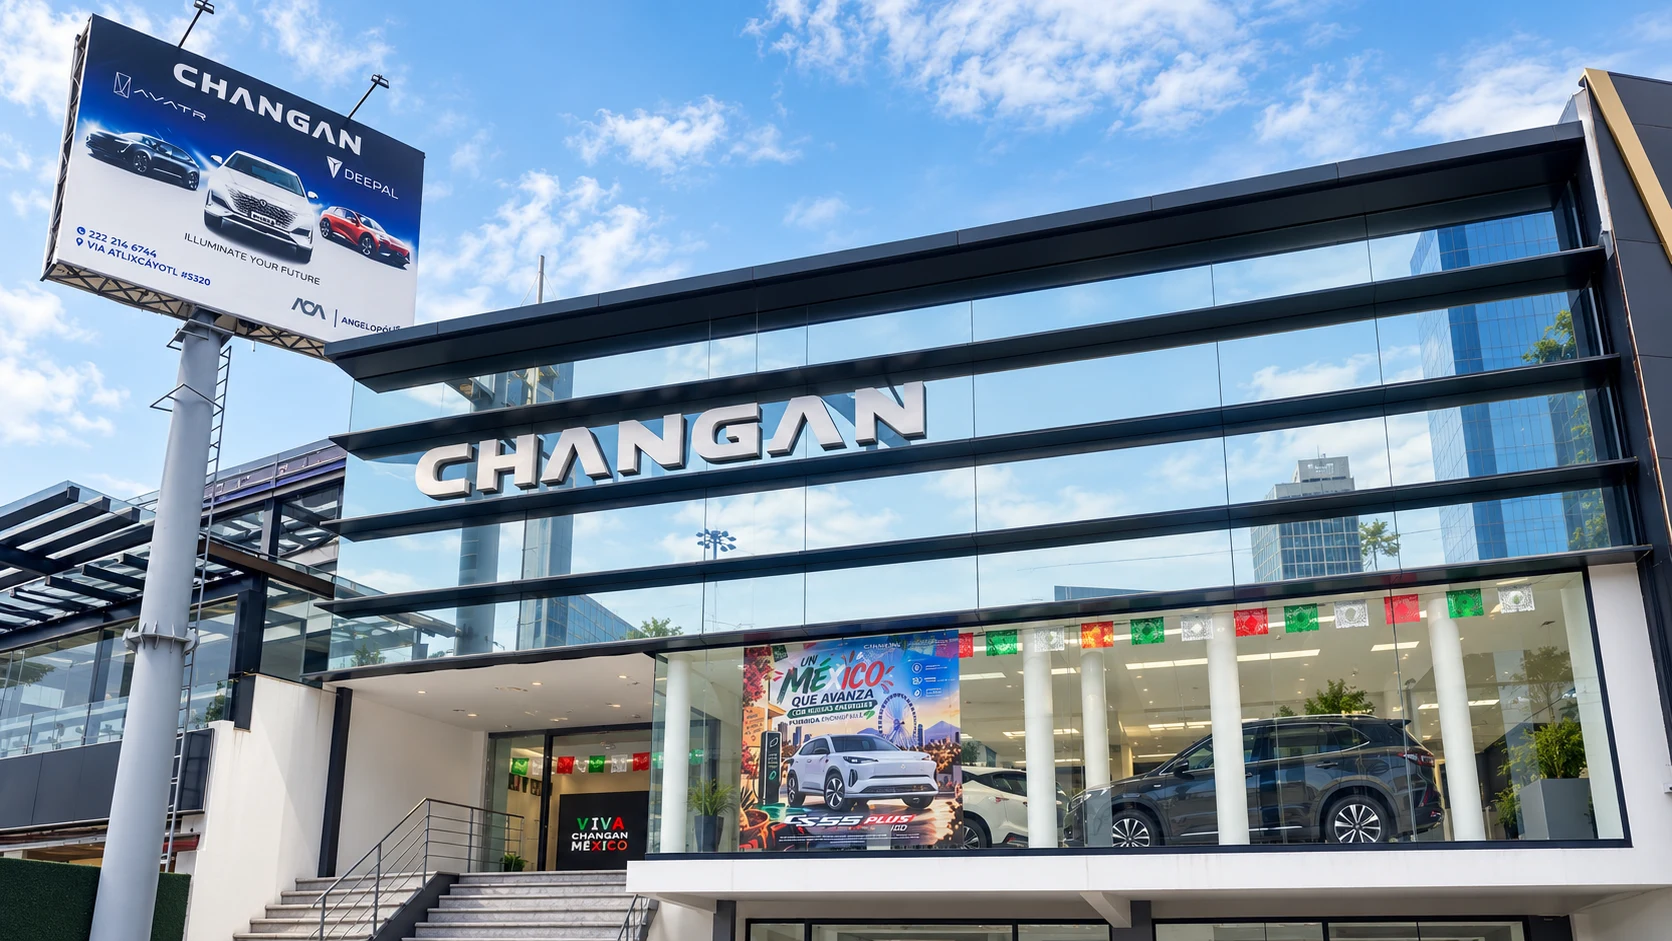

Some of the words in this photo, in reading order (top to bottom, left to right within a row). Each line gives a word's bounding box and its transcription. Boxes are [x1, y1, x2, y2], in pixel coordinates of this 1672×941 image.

[133, 89, 207, 121] AVATR
[173, 63, 362, 156] CHANGAN
[344, 168, 399, 200] DEEPAL
[88, 230, 108, 243] 222
[110, 236, 129, 249] 214
[131, 243, 157, 258] 6744
[184, 232, 247, 262] ILLUMINATE
[249, 255, 279, 272] YOUR
[280, 265, 321, 285] FUTURE
[87, 240, 106, 254] VIA
[107, 248, 178, 277] ATLIXCÁYOTL
[180, 271, 212, 287] #S320
[414, 380, 927, 501] CHANGAN
[801, 655, 818, 667] UN
[777, 657, 884, 704] MÉXICO
[791, 694, 818, 708] QUE
[820, 688, 874, 704] AVANZA
[571, 832, 629, 840] CHANGAN
[576, 816, 625, 830] VIVA
[784, 814, 864, 827] CS55
[863, 814, 914, 825] PLUS
